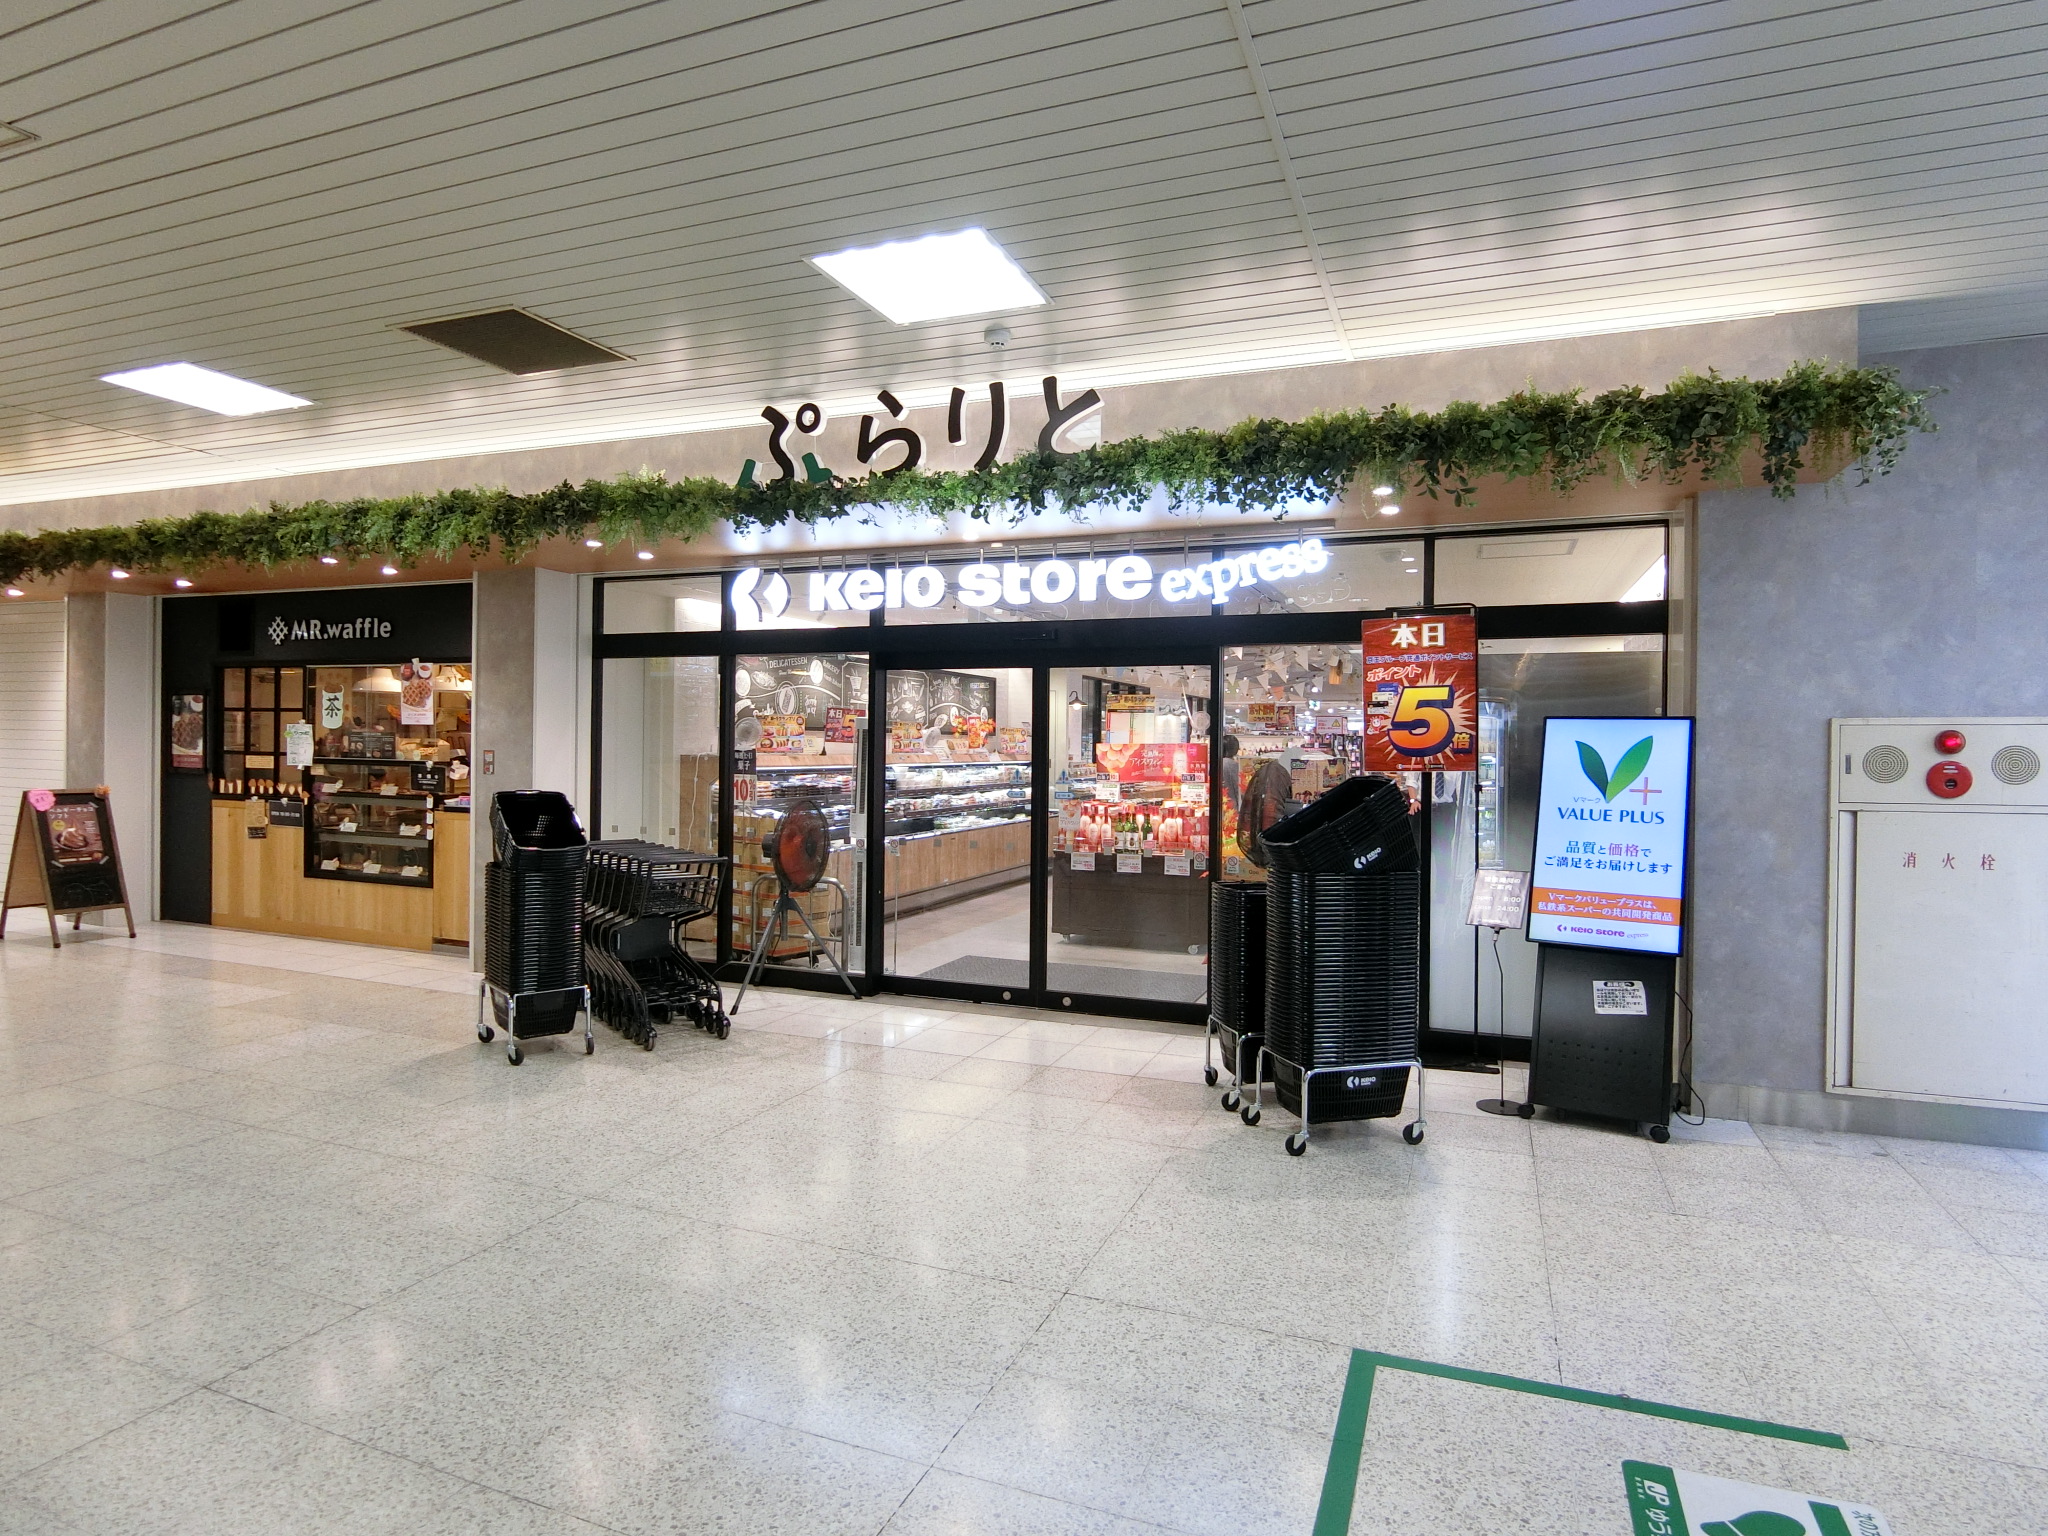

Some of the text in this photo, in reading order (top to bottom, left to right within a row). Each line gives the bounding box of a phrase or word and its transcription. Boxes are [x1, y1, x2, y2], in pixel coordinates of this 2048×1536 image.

[737, 375, 1102, 487] ぷらりと
[1160, 538, 1331, 605] express
[290, 618, 392, 640] MR.waffle
[1390, 622, 1445, 649] 本日
[1366, 664, 1422, 682] ポイント
[324, 695, 341, 718] 茶
[828, 709, 843, 719] 本日
[1387, 685, 1474, 757] 5 倍
[733, 779, 749, 801] 10
[1573, 796, 1601, 804] Vマーク
[1557, 806, 1665, 825] VALUE PLUS
[1565, 840, 1652, 858] 品質と価格で
[1544, 855, 1673, 875] ご満足をお届けします
[1902, 851, 1996, 871] 消火栓
[1548, 892, 1657, 910] Vマークバリュープラスは、
[1538, 902, 1673, 922] 私鉄系スーパーの共同開発商品
[1634, 1476, 1646, 1499] BANK
[1645, 1507, 1673, 1536] ゆう
